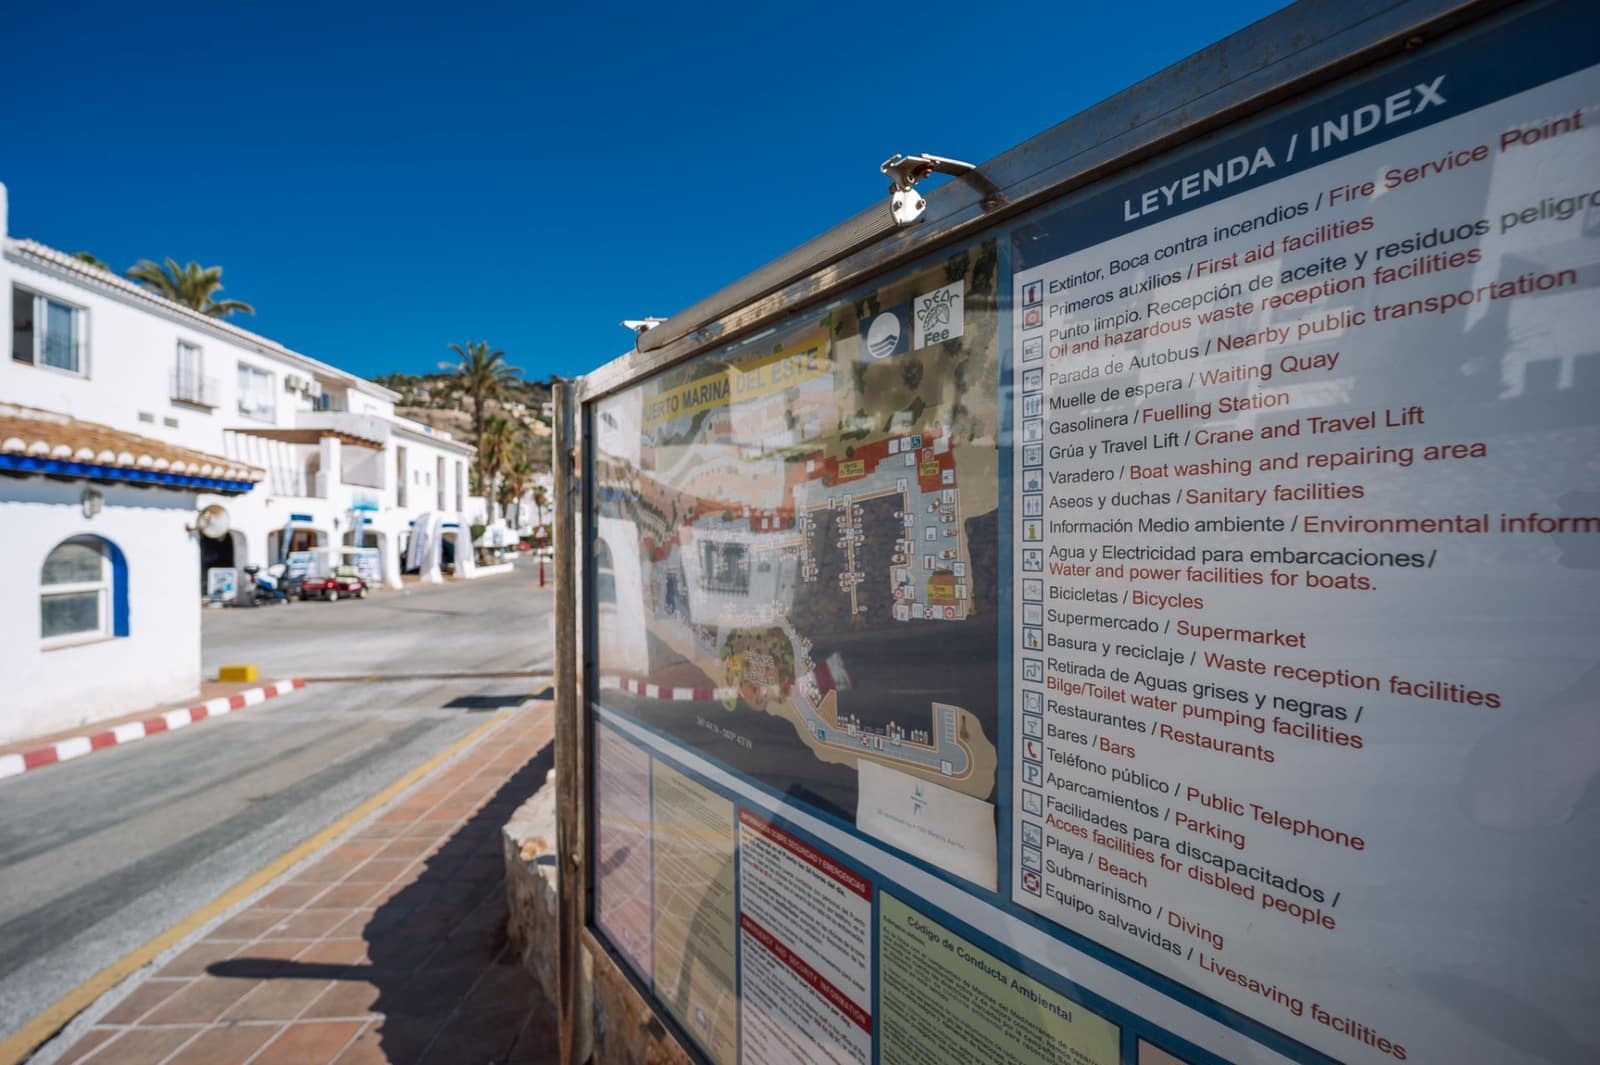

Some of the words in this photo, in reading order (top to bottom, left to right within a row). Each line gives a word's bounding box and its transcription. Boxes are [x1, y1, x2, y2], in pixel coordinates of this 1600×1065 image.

[1124, 146, 1276, 222] LEYENDA
[1311, 74, 1447, 152] INDEX
[1049, 268, 1105, 294] Extintor,
[1110, 252, 1149, 276] Boca
[1154, 234, 1208, 261] contra
[1214, 198, 1309, 239] incendios
[1329, 180, 1375, 207] Fire
[1384, 144, 1489, 189] Service
[1500, 107, 1585, 152] Point
[1050, 290, 1114, 318] Primeros
[1119, 270, 1182, 298] auxilios
[1196, 251, 1239, 278] First
[1244, 240, 1276, 264] aid
[1281, 215, 1375, 259] facilities
[1050, 323, 1090, 343] Punto
[1094, 311, 1143, 335] limpio.
[1147, 283, 1242, 318] Recepción
[1248, 273, 1274, 292] de
[1280, 255, 1347, 284] aceite
[1354, 250, 1368, 270] y
[1375, 217, 1490, 261] residuos
[1050, 343, 1068, 361] Oil
[1072, 337, 1099, 355] and
[1104, 317, 1192, 348] hazardous
[1198, 301, 1255, 326] waste
[1261, 273, 1366, 310] reception
[1374, 247, 1482, 285] facilities
[1050, 366, 1099, 386] Parada
[1104, 357, 1124, 376] de
[1129, 343, 1199, 370] Autobus
[1217, 325, 1290, 352] Nearby
[1298, 310, 1366, 340] public
[1374, 269, 1578, 322] transportation
[641, 392, 680, 421] UERTO
[682, 377, 731, 409] MARINA
[772, 346, 819, 384] ESTE
[1049, 391, 1096, 411] Muelle
[1100, 387, 1120, 403] de
[1125, 375, 1183, 398] espera
[1200, 361, 1272, 386] Waiting
[1280, 352, 1340, 375] Quay
[1050, 414, 1128, 436] Gasolinera
[1143, 401, 1212, 424] Fuelling
[1218, 392, 1290, 414] Station
[1049, 467, 1115, 485] Varadero
[1130, 463, 1169, 481] Boat
[1174, 457, 1252, 478] washing
[1259, 452, 1299, 472] and
[1306, 446, 1415, 471] repairing
[1423, 442, 1488, 462] area
[1050, 443, 1084, 460] Grúa
[1089, 444, 1097, 459] y
[1101, 437, 1148, 455] Travel
[1153, 431, 1180, 449] Lift
[1195, 427, 1254, 446] Crane
[1260, 420, 1300, 440] and
[1307, 411, 1376, 435] Travel
[1385, 406, 1425, 428] Lift
[1049, 494, 1093, 509] Aseos
[1097, 497, 1107, 511] y
[1111, 489, 1171, 508] duchas
[1186, 487, 1266, 506] Sanitary
[1273, 482, 1365, 502] facilities
[1049, 518, 1133, 534] Información
[1138, 517, 1190, 534] Medio
[1195, 516, 1285, 533] ambiente
[1303, 513, 1489, 534] Environmental
[1049, 545, 1085, 562] Agua
[1090, 548, 1098, 563] y
[1102, 544, 1196, 562] Electricidad
[1202, 549, 1244, 565] para
[1049, 562, 1091, 577] Water
[1095, 564, 1125, 578] and
[1130, 567, 1182, 583] power
[1187, 565, 1264, 585] facilities
[1271, 568, 1299, 587] for
[1306, 570, 1377, 591] boats.
[1047, 609, 1160, 633] Supermercado
[1176, 619, 1307, 648] Supermarket
[1049, 586, 1118, 603] Bicicletas
[1132, 590, 1204, 610] Bicycles
[1047, 633, 1098, 652] Basura
[1102, 642, 1111, 657] y
[1116, 643, 1185, 665] reciclaje
[1204, 651, 1267, 675] Waste
[1273, 663, 1381, 691] reception
[1389, 675, 1502, 709] facilities
[1047, 657, 1106, 680] Retirada
[1110, 667, 1130, 683] de
[1134, 671, 1187, 694] Aguas
[1192, 682, 1249, 704] grises
[1254, 694, 1267, 709] y
[1272, 695, 1348, 721] negras
[1046, 676, 1126, 702] Bilge/Toilet
[1130, 691, 1177, 712] water
[1182, 702, 1266, 734] pumping
[1271, 716, 1364, 749] facilities
[1047, 699, 1146, 733] Restaurantes
[1159, 723, 1276, 763] Restaurants
[1047, 723, 1088, 745] Bares
[1100, 736, 1136, 759] Bars
[1046, 772, 1159, 819] Aparcamientos
[1175, 811, 1246, 851] Parking
[1047, 747, 1107, 777] Teléfono
[1111, 767, 1170, 794] público
[1186, 786, 1245, 817] Public
[1249, 803, 1365, 851] Telephone
[1045, 813, 1088, 839] Acces
[1092, 829, 1155, 864] facilities
[1160, 852, 1183, 873] for
[1188, 864, 1255, 901] disbled
[1262, 891, 1337, 930] people
[1046, 835, 1084, 862] Playa
[1098, 856, 1148, 888] Beach
[1047, 796, 1128, 834] Facilidades
[1133, 826, 1170, 850] para
[1175, 840, 1325, 904] discapacitados
[1046, 858, 1152, 915] Submarinismo
[1167, 910, 1224, 950] Diving
[907, 915, 941, 944] Código
[942, 938, 955, 953] de
[957, 945, 1009, 985] Conducta
[1010, 978, 1073, 1023] Ambiental
[1045, 882, 1094, 916] Equipo
[1098, 908, 1182, 957] salvavidas
[1199, 952, 1304, 1017] Livesaving
[1310, 1003, 1407, 1061] facilities
